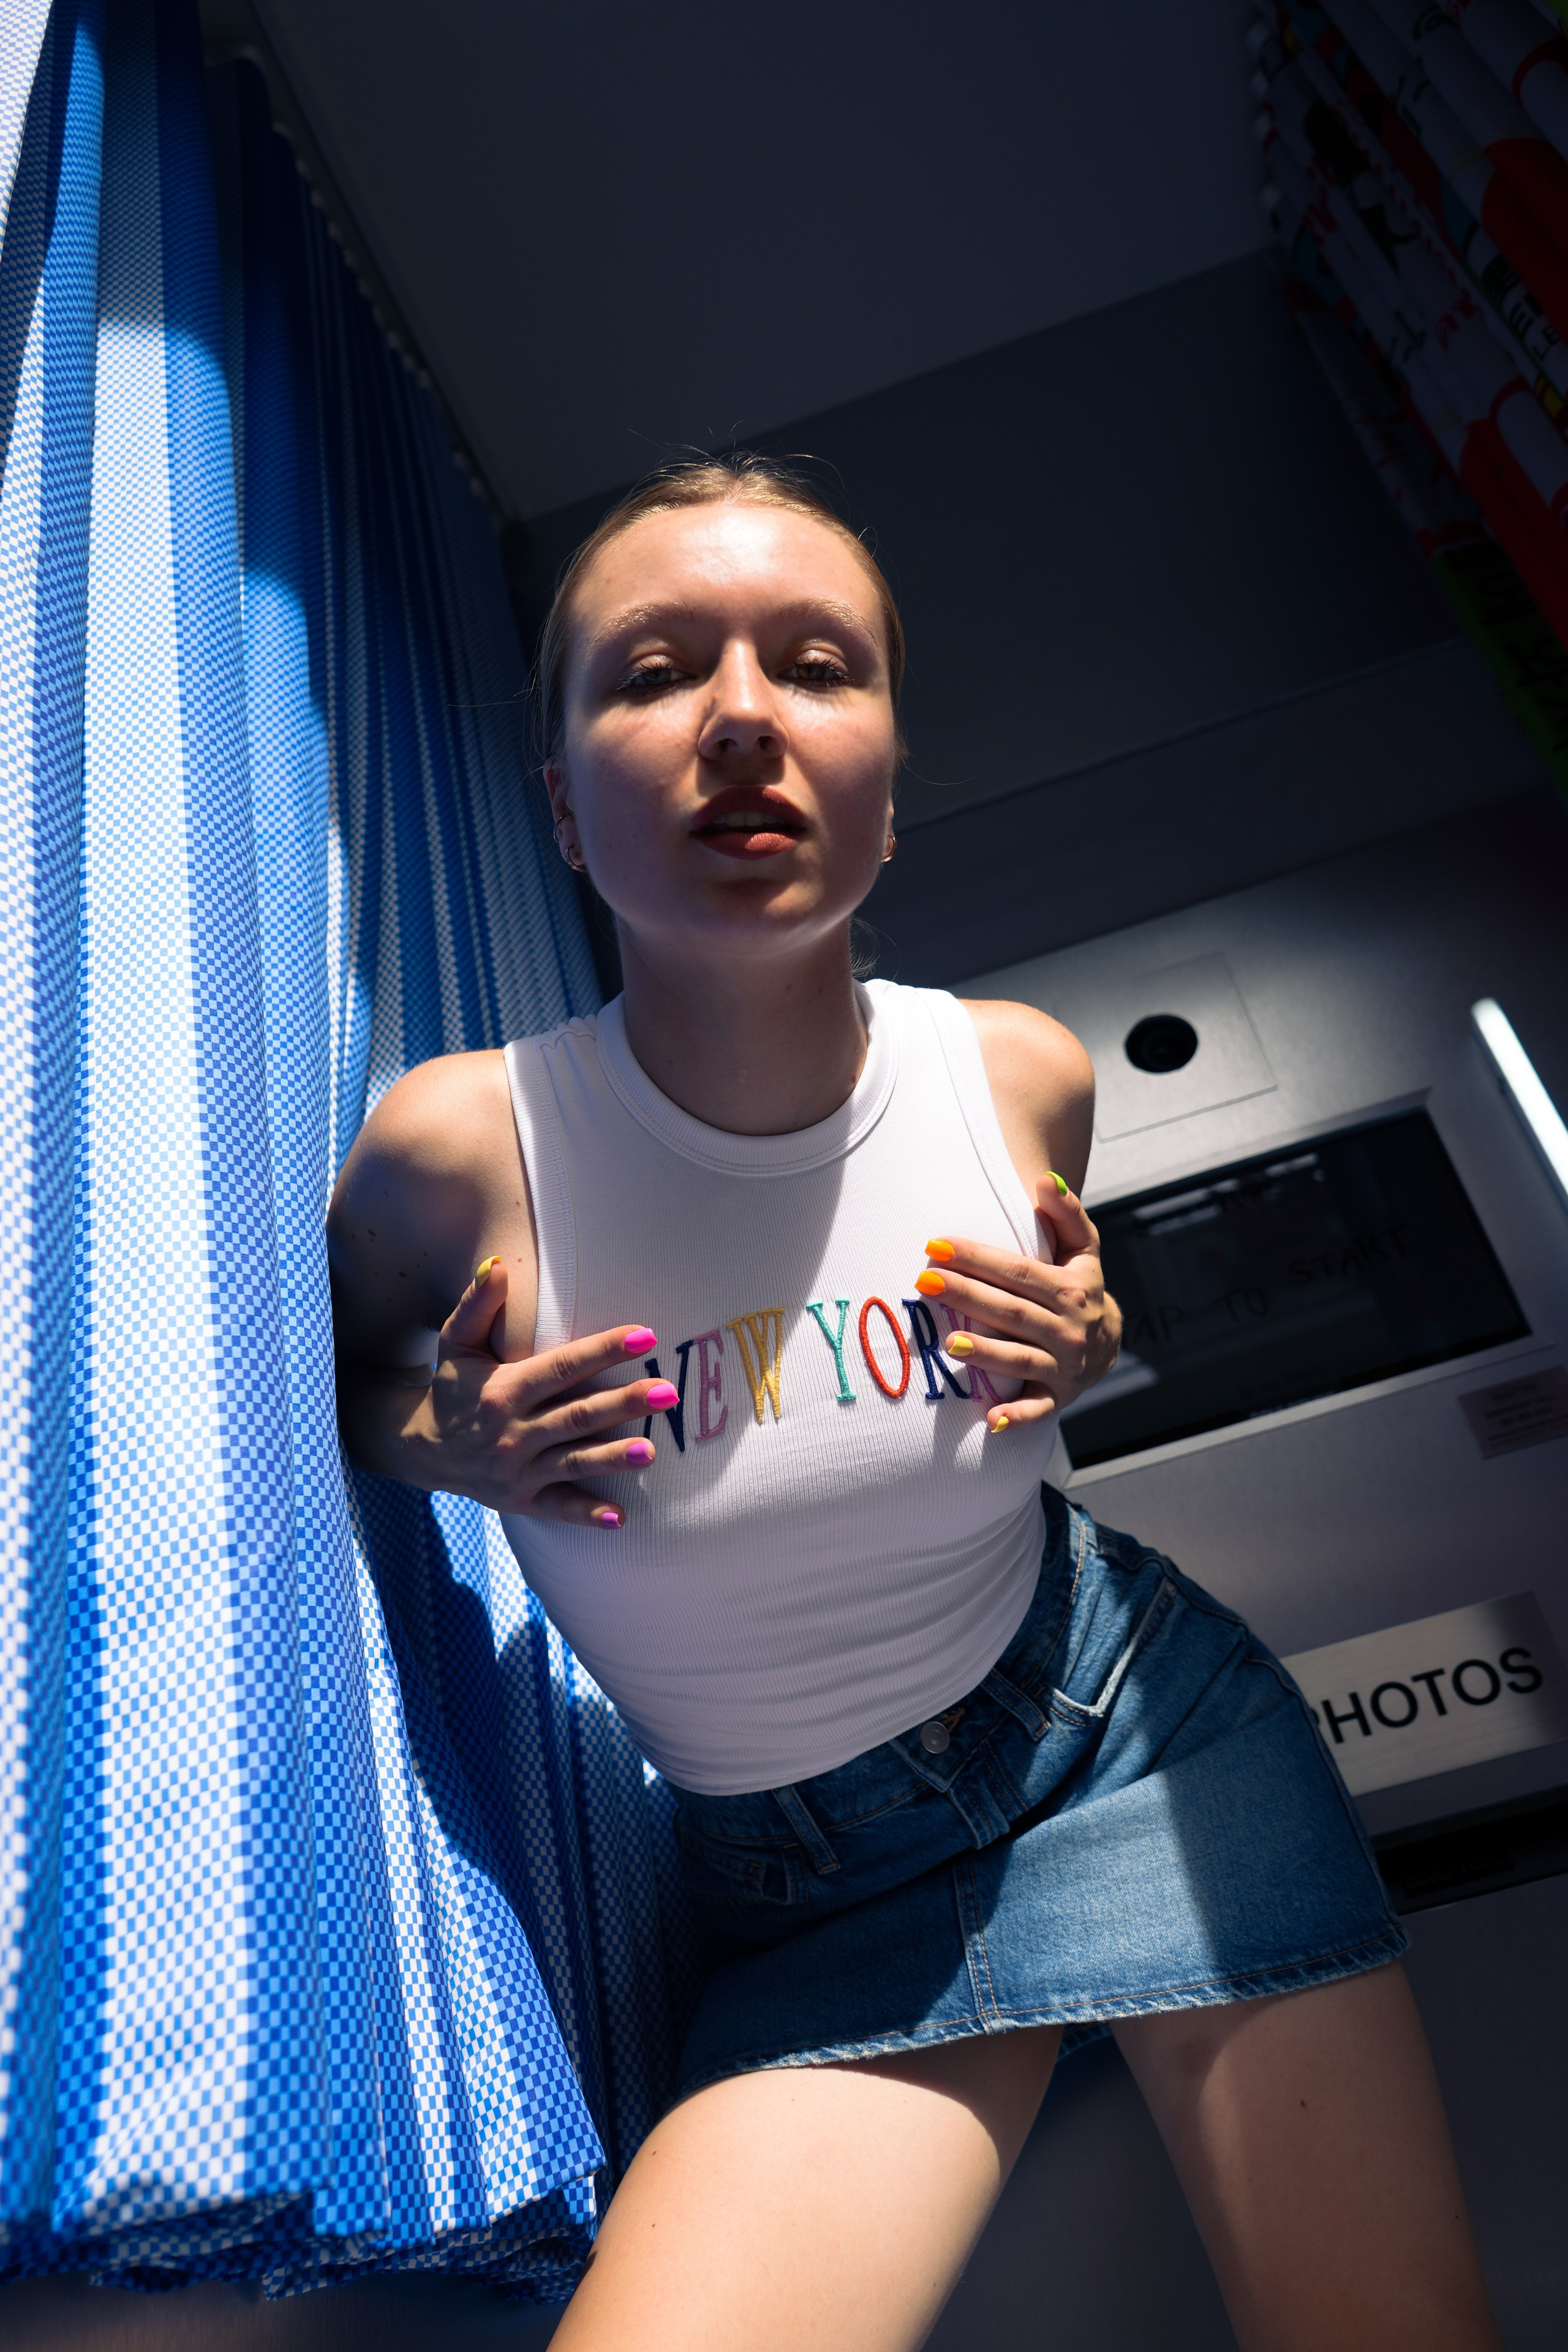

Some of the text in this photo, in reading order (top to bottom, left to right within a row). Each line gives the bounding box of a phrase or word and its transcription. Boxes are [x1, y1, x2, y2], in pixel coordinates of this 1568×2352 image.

[1218, 1288, 1268, 1323] TO
[1287, 1223, 1409, 1285] START
[644, 1306, 785, 1452] NEW
[1310, 1646, 1542, 1743] HOTOS
